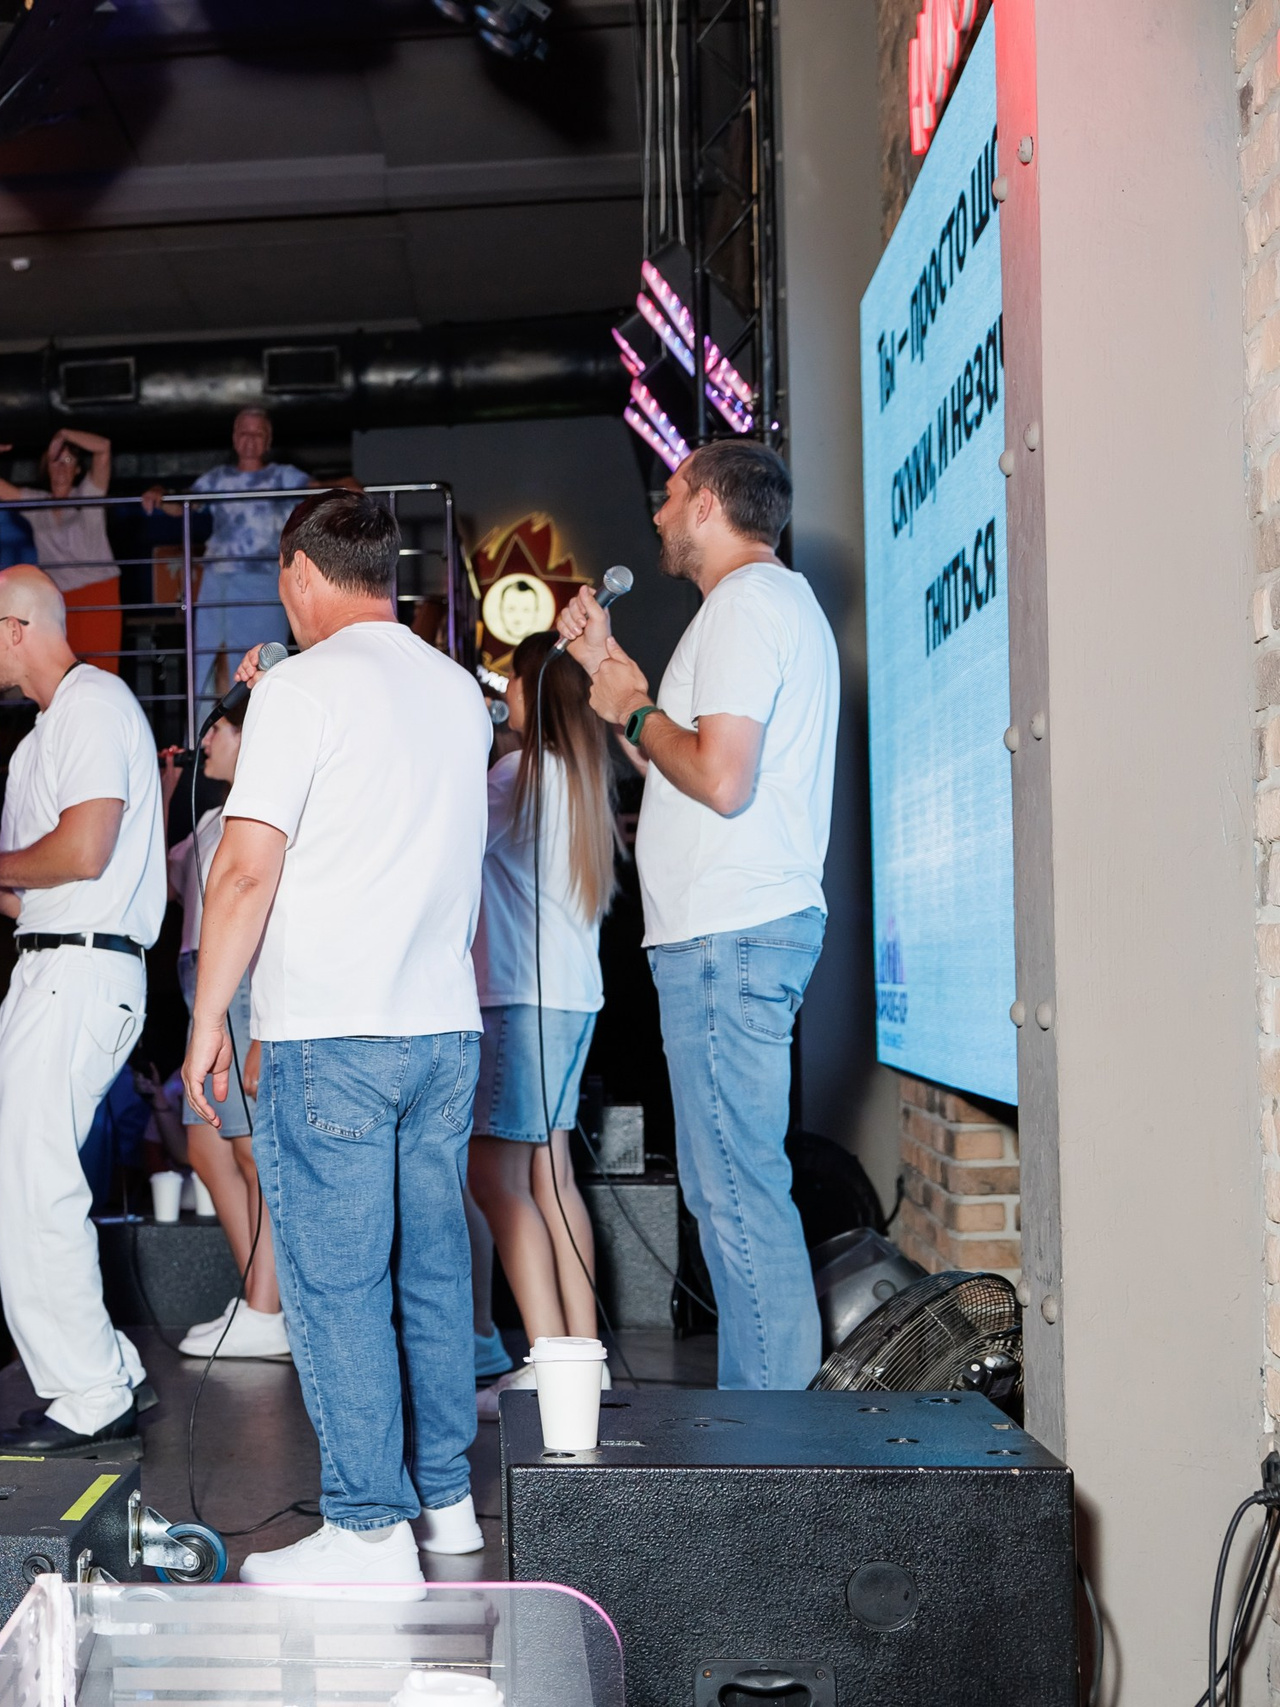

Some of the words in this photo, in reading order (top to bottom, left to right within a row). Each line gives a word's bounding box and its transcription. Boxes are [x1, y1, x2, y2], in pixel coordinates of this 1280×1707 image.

[877, 330, 895, 413] Ты
[910, 190, 968, 363] просто
[891, 421, 936, 538] скуки,
[937, 396, 949, 478] и
[925, 517, 996, 658] гнаться
